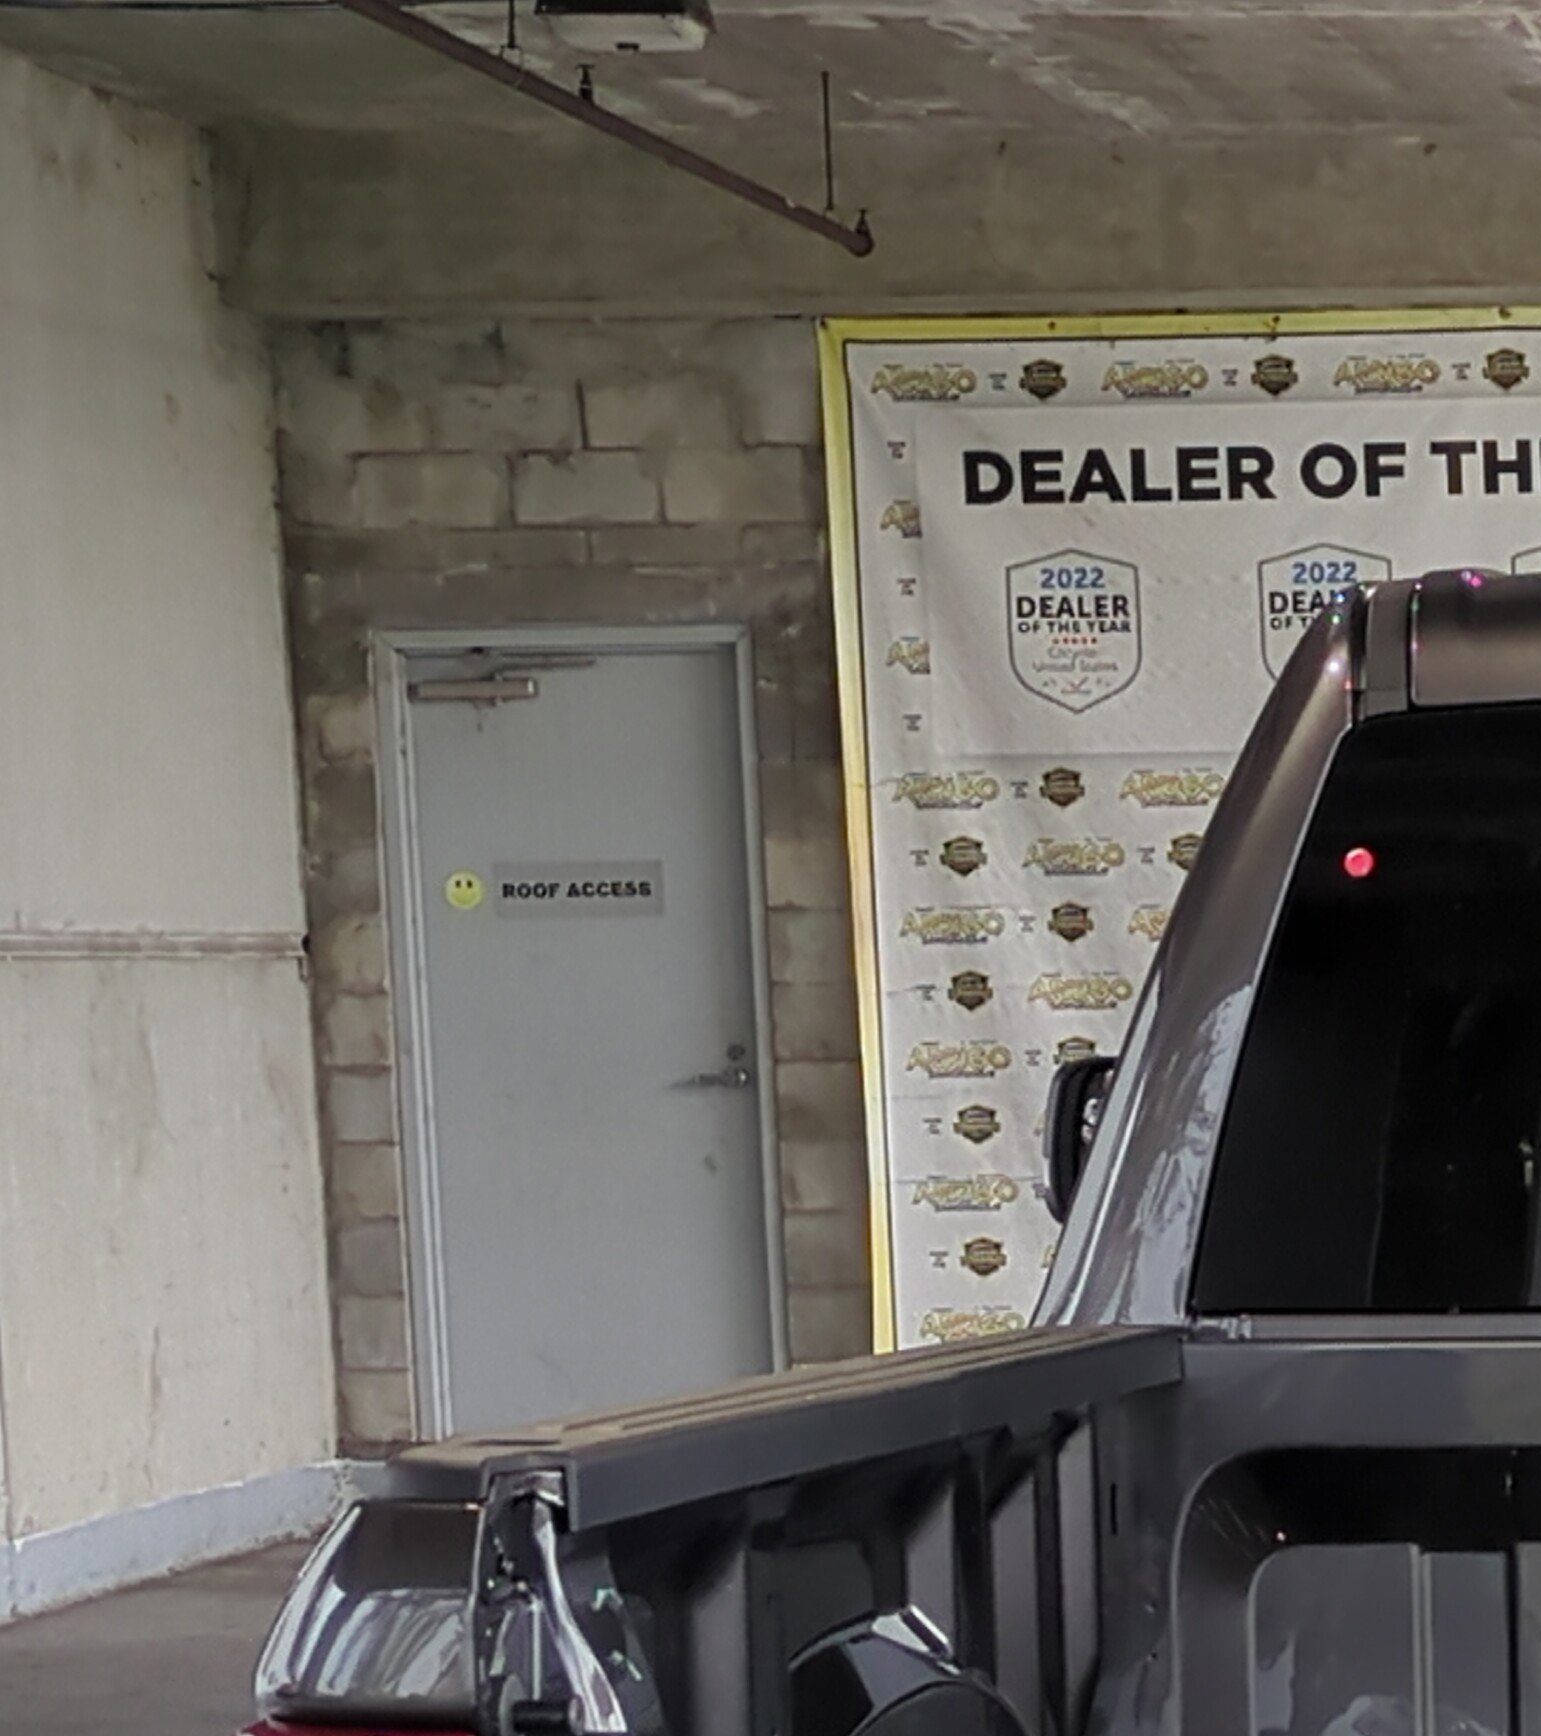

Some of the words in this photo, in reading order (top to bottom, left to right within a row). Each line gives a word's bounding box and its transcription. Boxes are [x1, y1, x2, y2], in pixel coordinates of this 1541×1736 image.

[962, 445, 1277, 506] DEALER
[1299, 442, 1407, 499] OF
[1040, 566, 1105, 589] 2022
[1292, 561, 1357, 584] 2022
[1016, 594, 1130, 619] DEALER
[1018, 621, 1041, 634] OF
[1047, 621, 1081, 634] THE
[1087, 620, 1132, 634] YEAR
[1269, 616, 1293, 631] OF
[501, 882, 561, 899] ROOF
[566, 880, 652, 898] ACCESS
